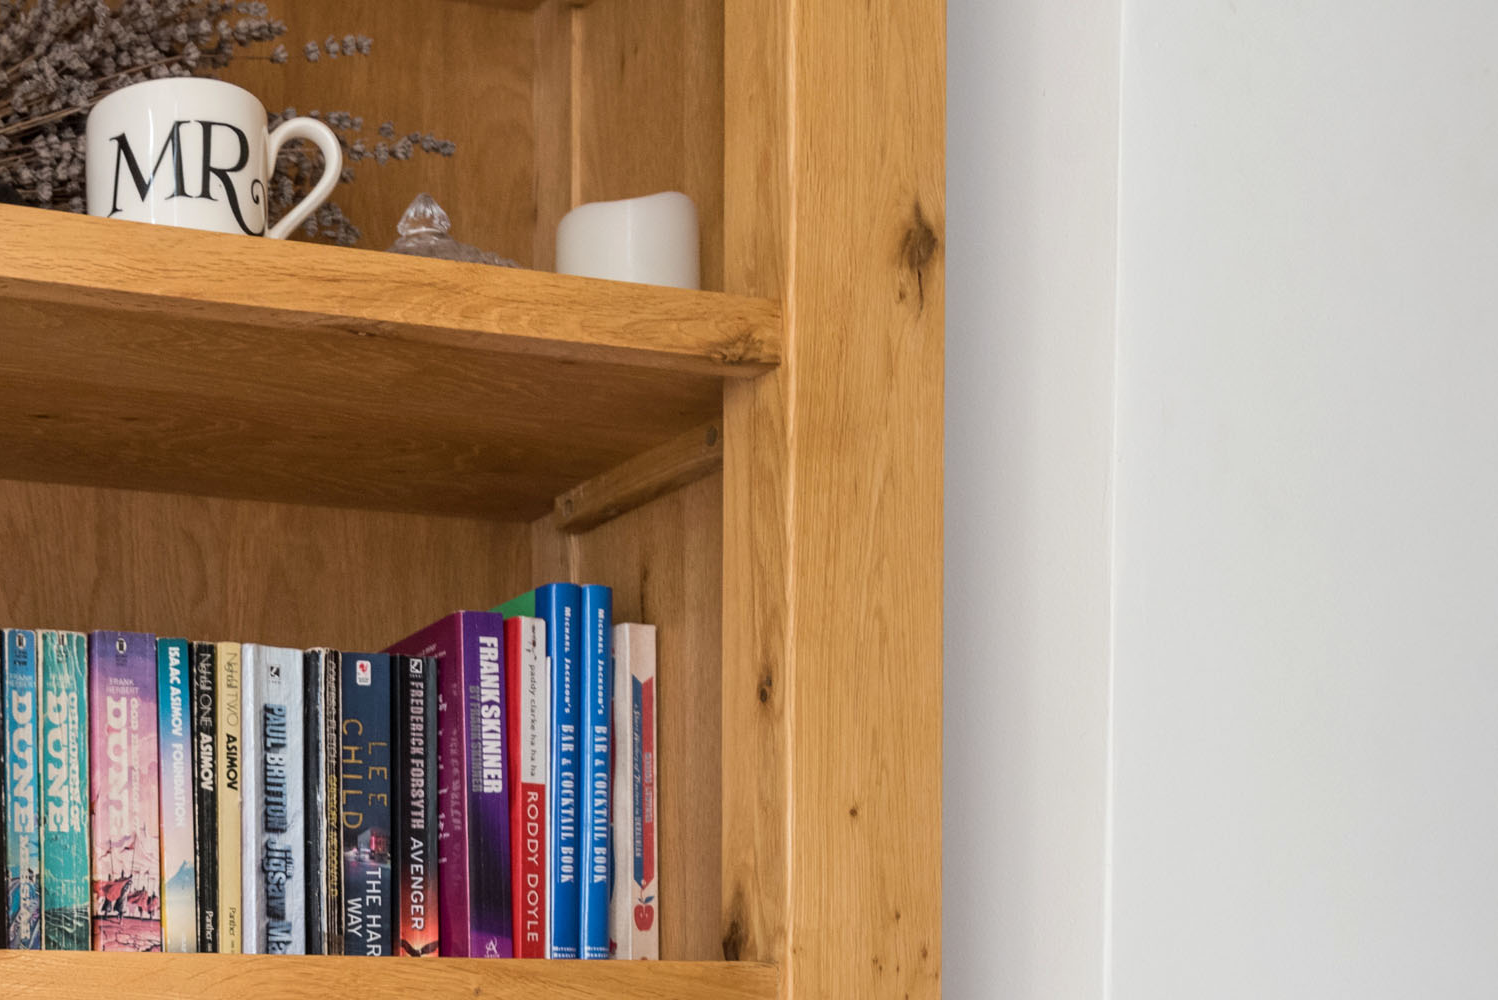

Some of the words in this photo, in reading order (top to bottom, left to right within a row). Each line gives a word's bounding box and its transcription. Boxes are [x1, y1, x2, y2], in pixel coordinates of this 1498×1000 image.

[110, 121, 266, 236] MR
[109, 678, 134, 686] FRANK
[167, 646, 180, 684] ISAAC
[478, 636, 500, 706] FRANK
[169, 687, 183, 737] ASIMOV
[201, 694, 213, 730] ONE
[226, 691, 239, 728] TWO
[409, 681, 424, 754] FREDERICK
[561, 724, 574, 753] BAR
[594, 725, 608, 753] BAR
[12, 690, 34, 832] DUNE
[46, 691, 69, 832] DUNE
[200, 732, 213, 791] ASIMOV
[226, 733, 238, 791] ASIMOV
[343, 719, 363, 829] CHILD
[368, 741, 388, 807] LEE
[480, 708, 503, 794] SKINNER
[561, 757, 574, 766] &
[594, 758, 607, 767] &
[171, 743, 184, 828] FOUNDATION
[409, 758, 425, 830] FORSYTH
[561, 769, 574, 841] COCKTAIL
[594, 769, 608, 841] COCKTAIL
[527, 790, 539, 867] RODDY
[410, 837, 424, 931] AVENGER
[561, 845, 574, 884] BOOK
[593, 845, 608, 884] BOOK
[205, 910, 213, 942] Panther
[347, 897, 363, 938] WAY
[527, 872, 539, 943] DOYLE
